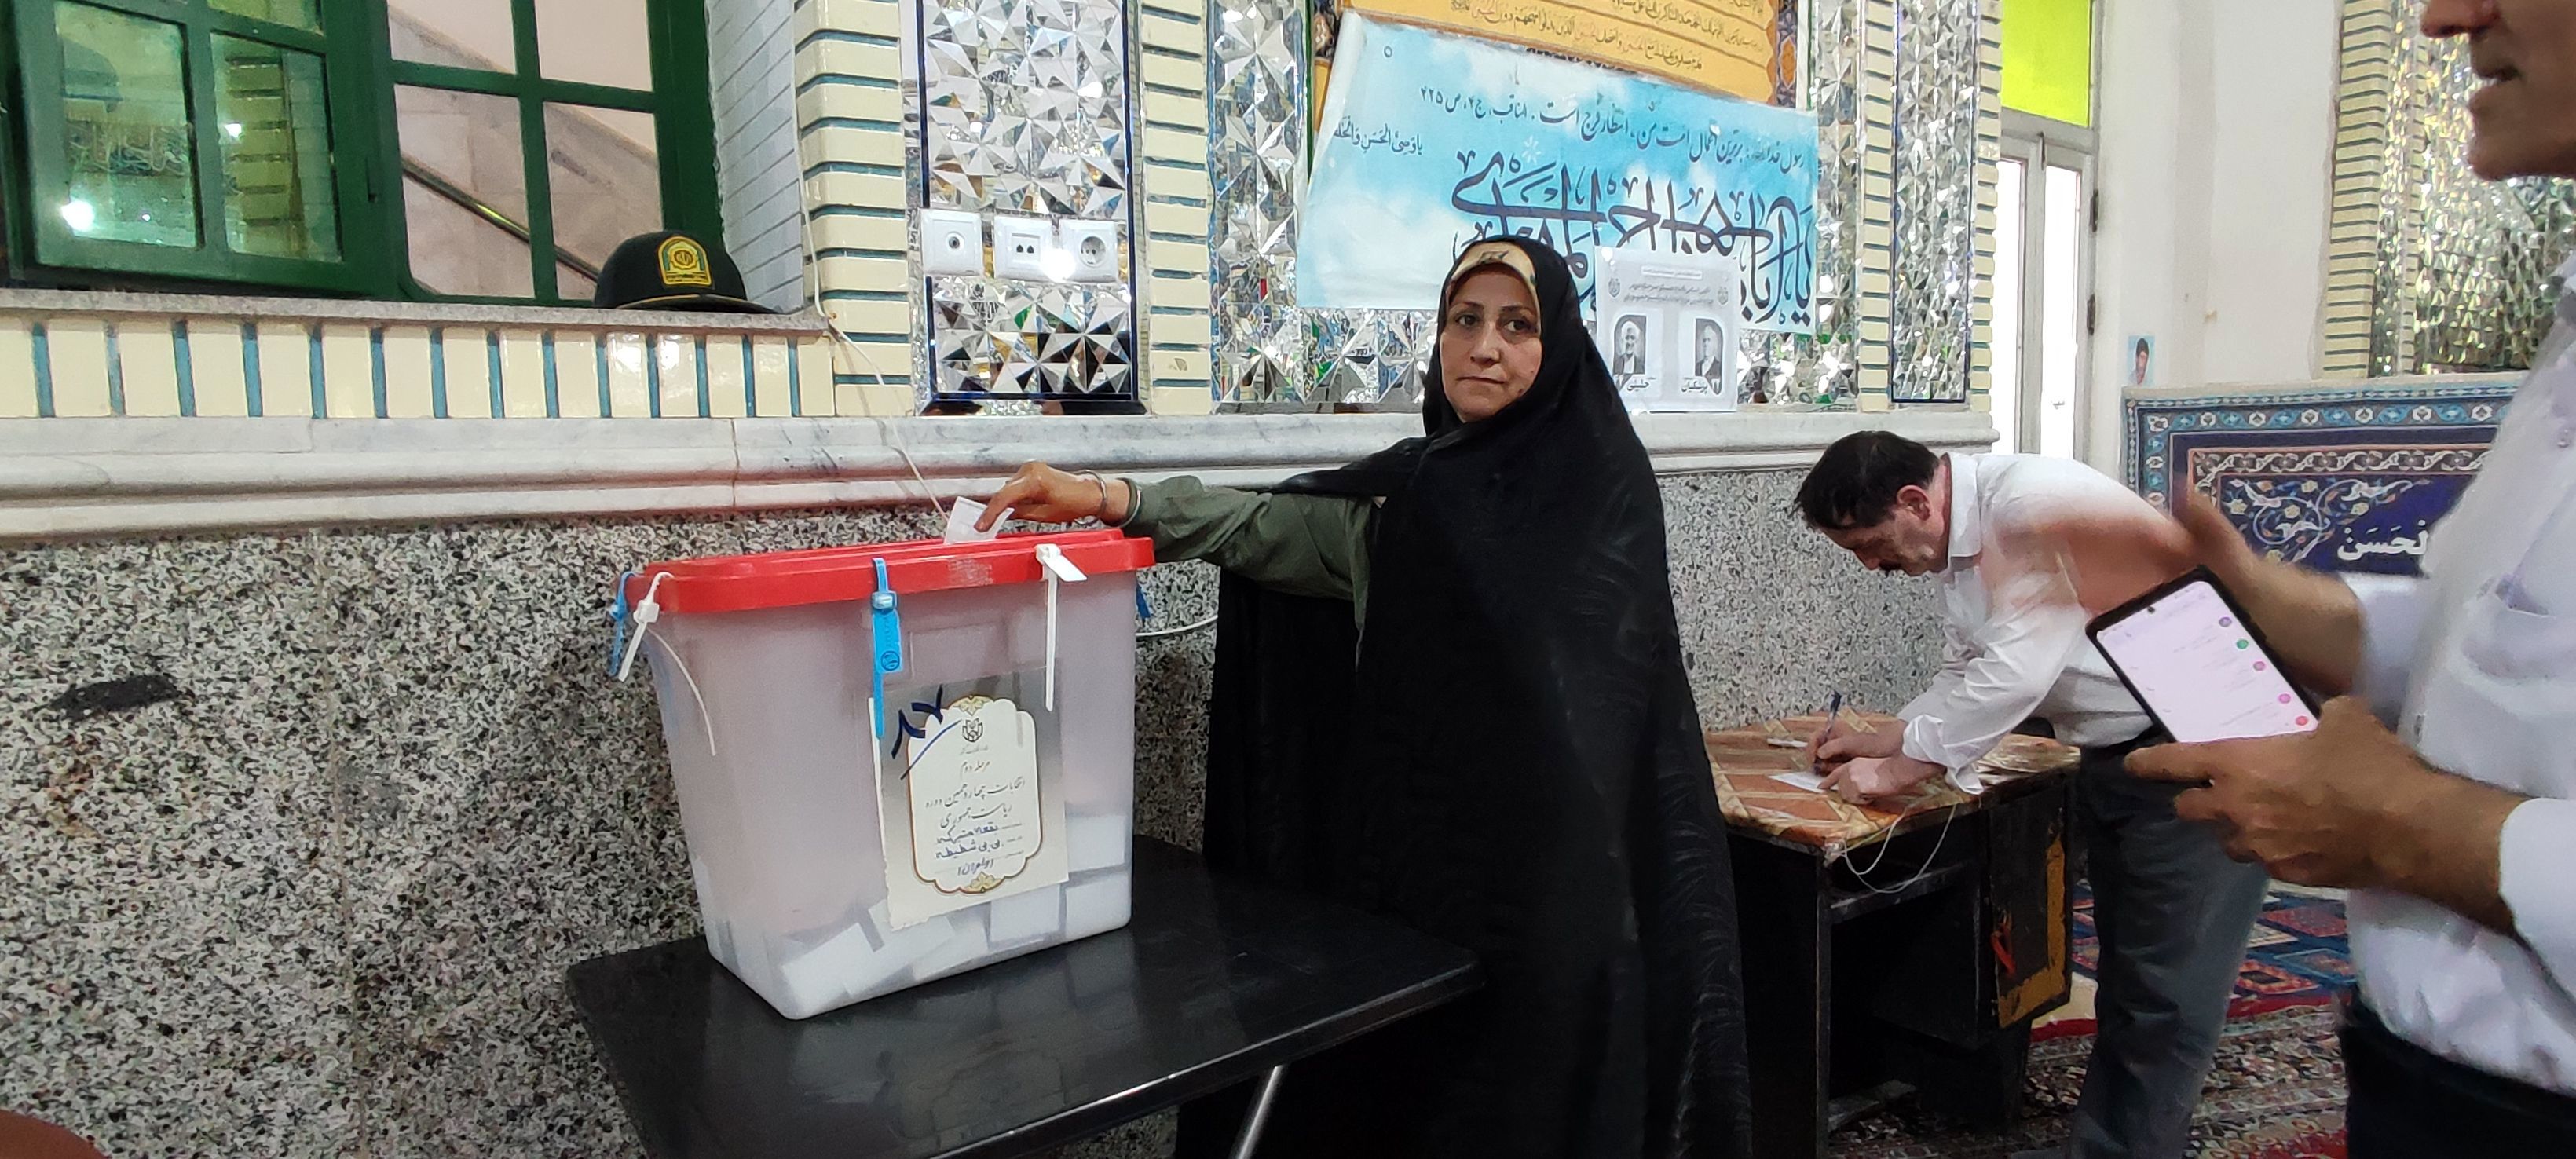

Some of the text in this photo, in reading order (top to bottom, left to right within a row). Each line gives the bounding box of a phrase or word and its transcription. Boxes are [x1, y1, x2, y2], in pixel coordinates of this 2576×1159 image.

[987, 776, 1026, 795] انتخابات
[940, 802, 1012, 829] ریاست جمهوری
